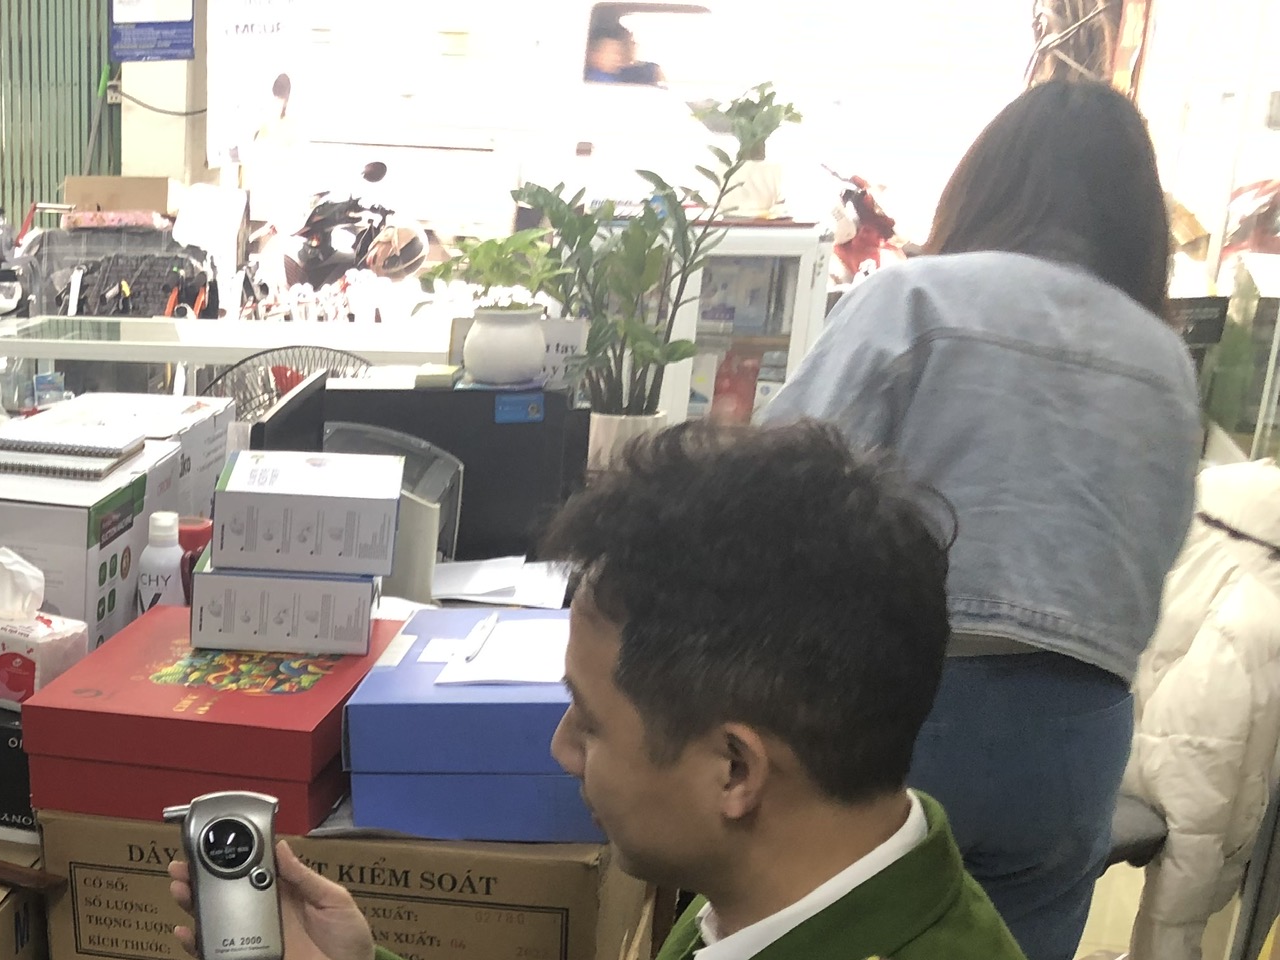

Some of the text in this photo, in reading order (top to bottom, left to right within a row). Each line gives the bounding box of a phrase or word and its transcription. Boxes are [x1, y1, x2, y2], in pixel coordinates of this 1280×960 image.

[140, 573, 172, 587] CHY
[1, 812, 33, 826] ONY
[128, 843, 498, 896] DÂY KIỂM SOÁT
[222, 936, 262, 948] CA 2000
[393, 930, 441, 948] XUẤT:
